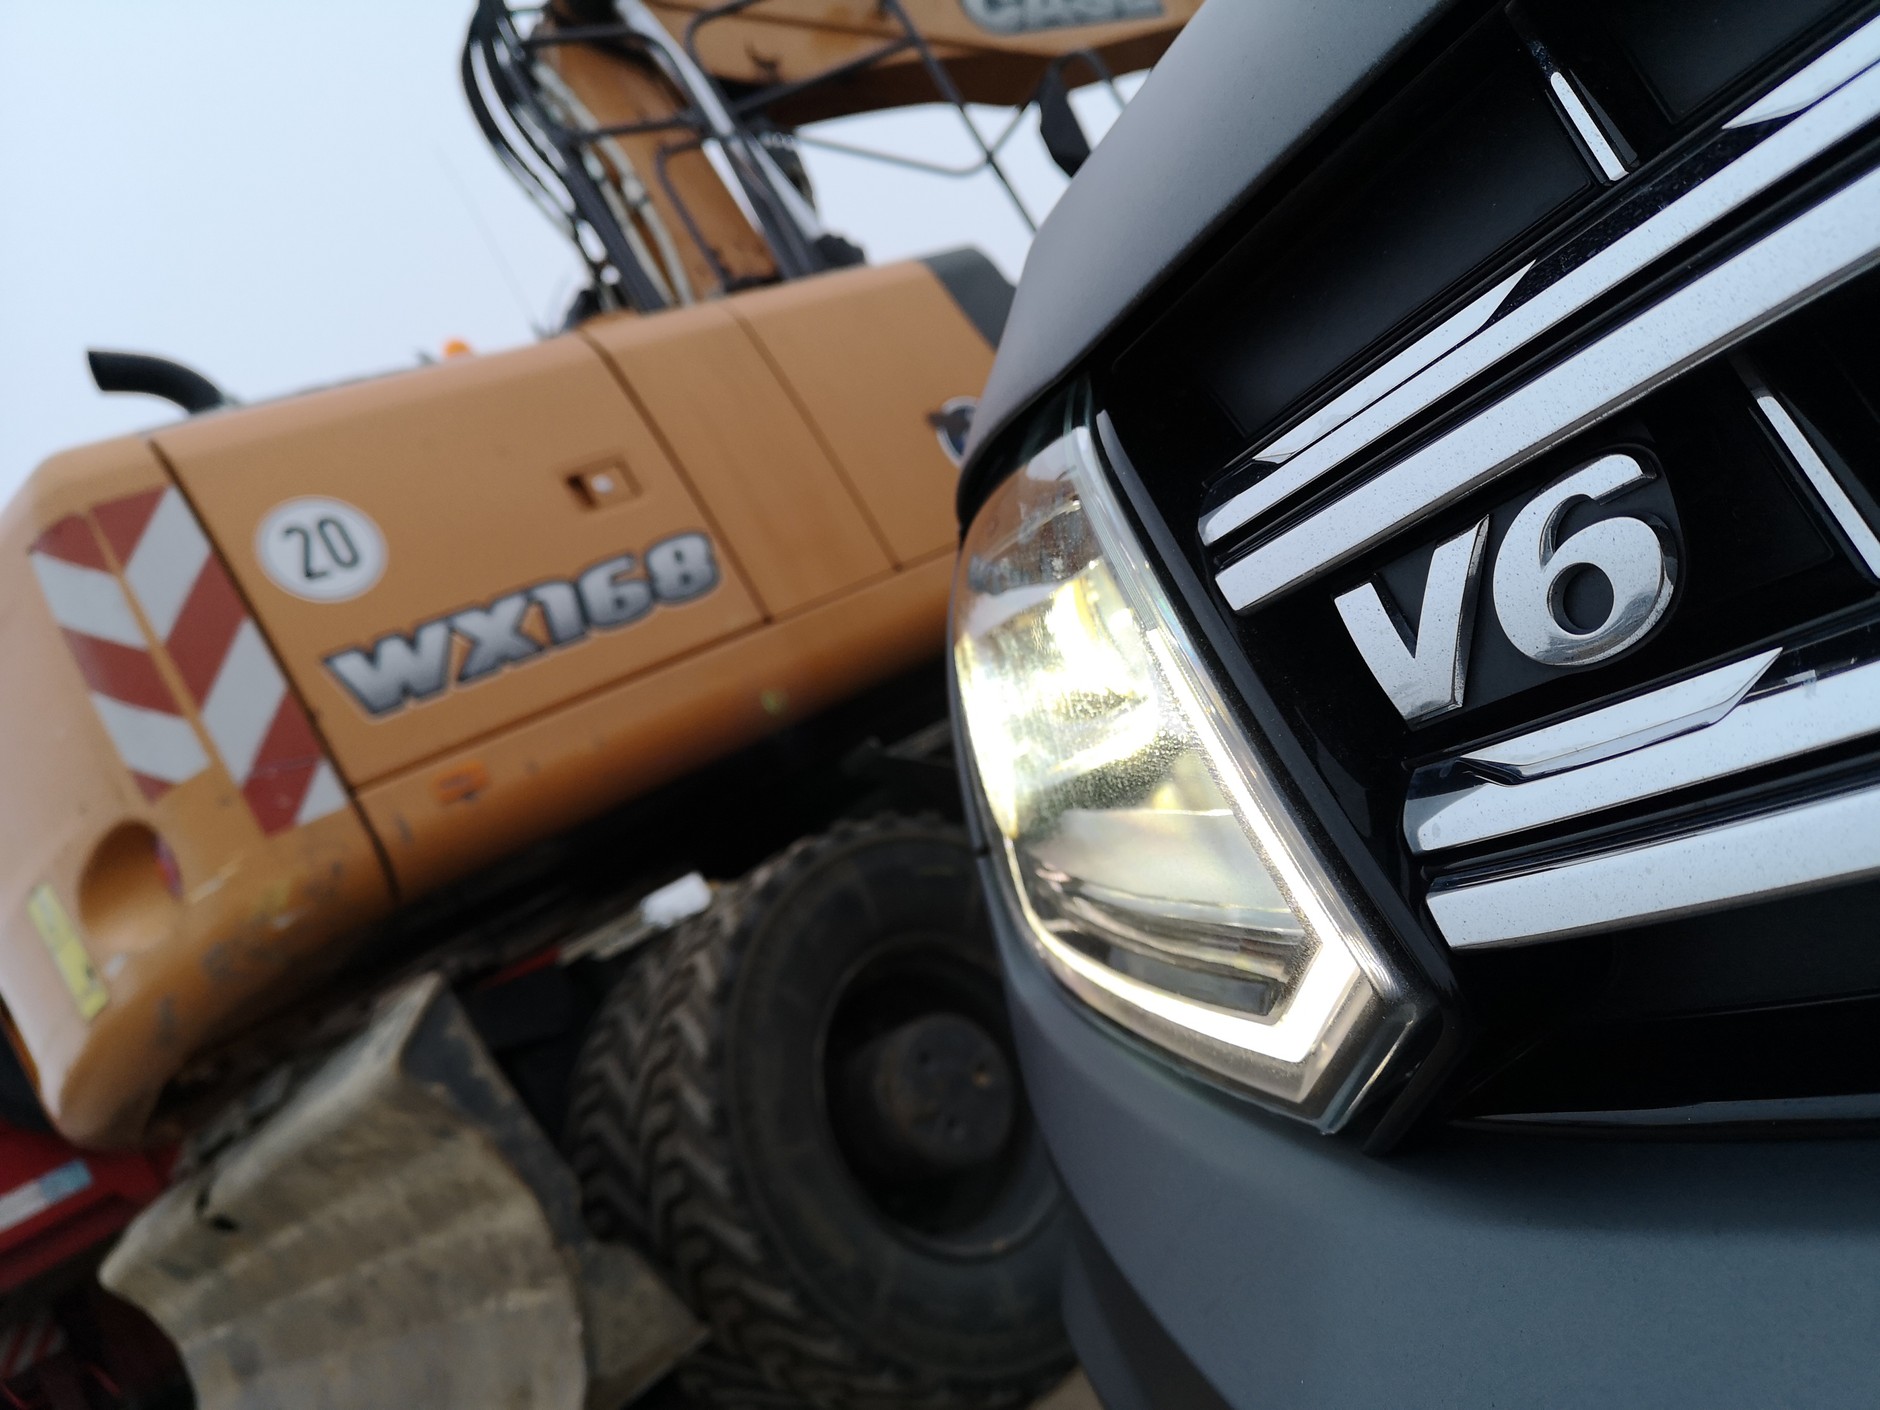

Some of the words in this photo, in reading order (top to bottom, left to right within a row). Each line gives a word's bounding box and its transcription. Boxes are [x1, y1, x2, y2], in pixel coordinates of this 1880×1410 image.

[283, 518, 360, 579] 20
[323, 530, 721, 716] WX168
[1333, 453, 1677, 730] V6
